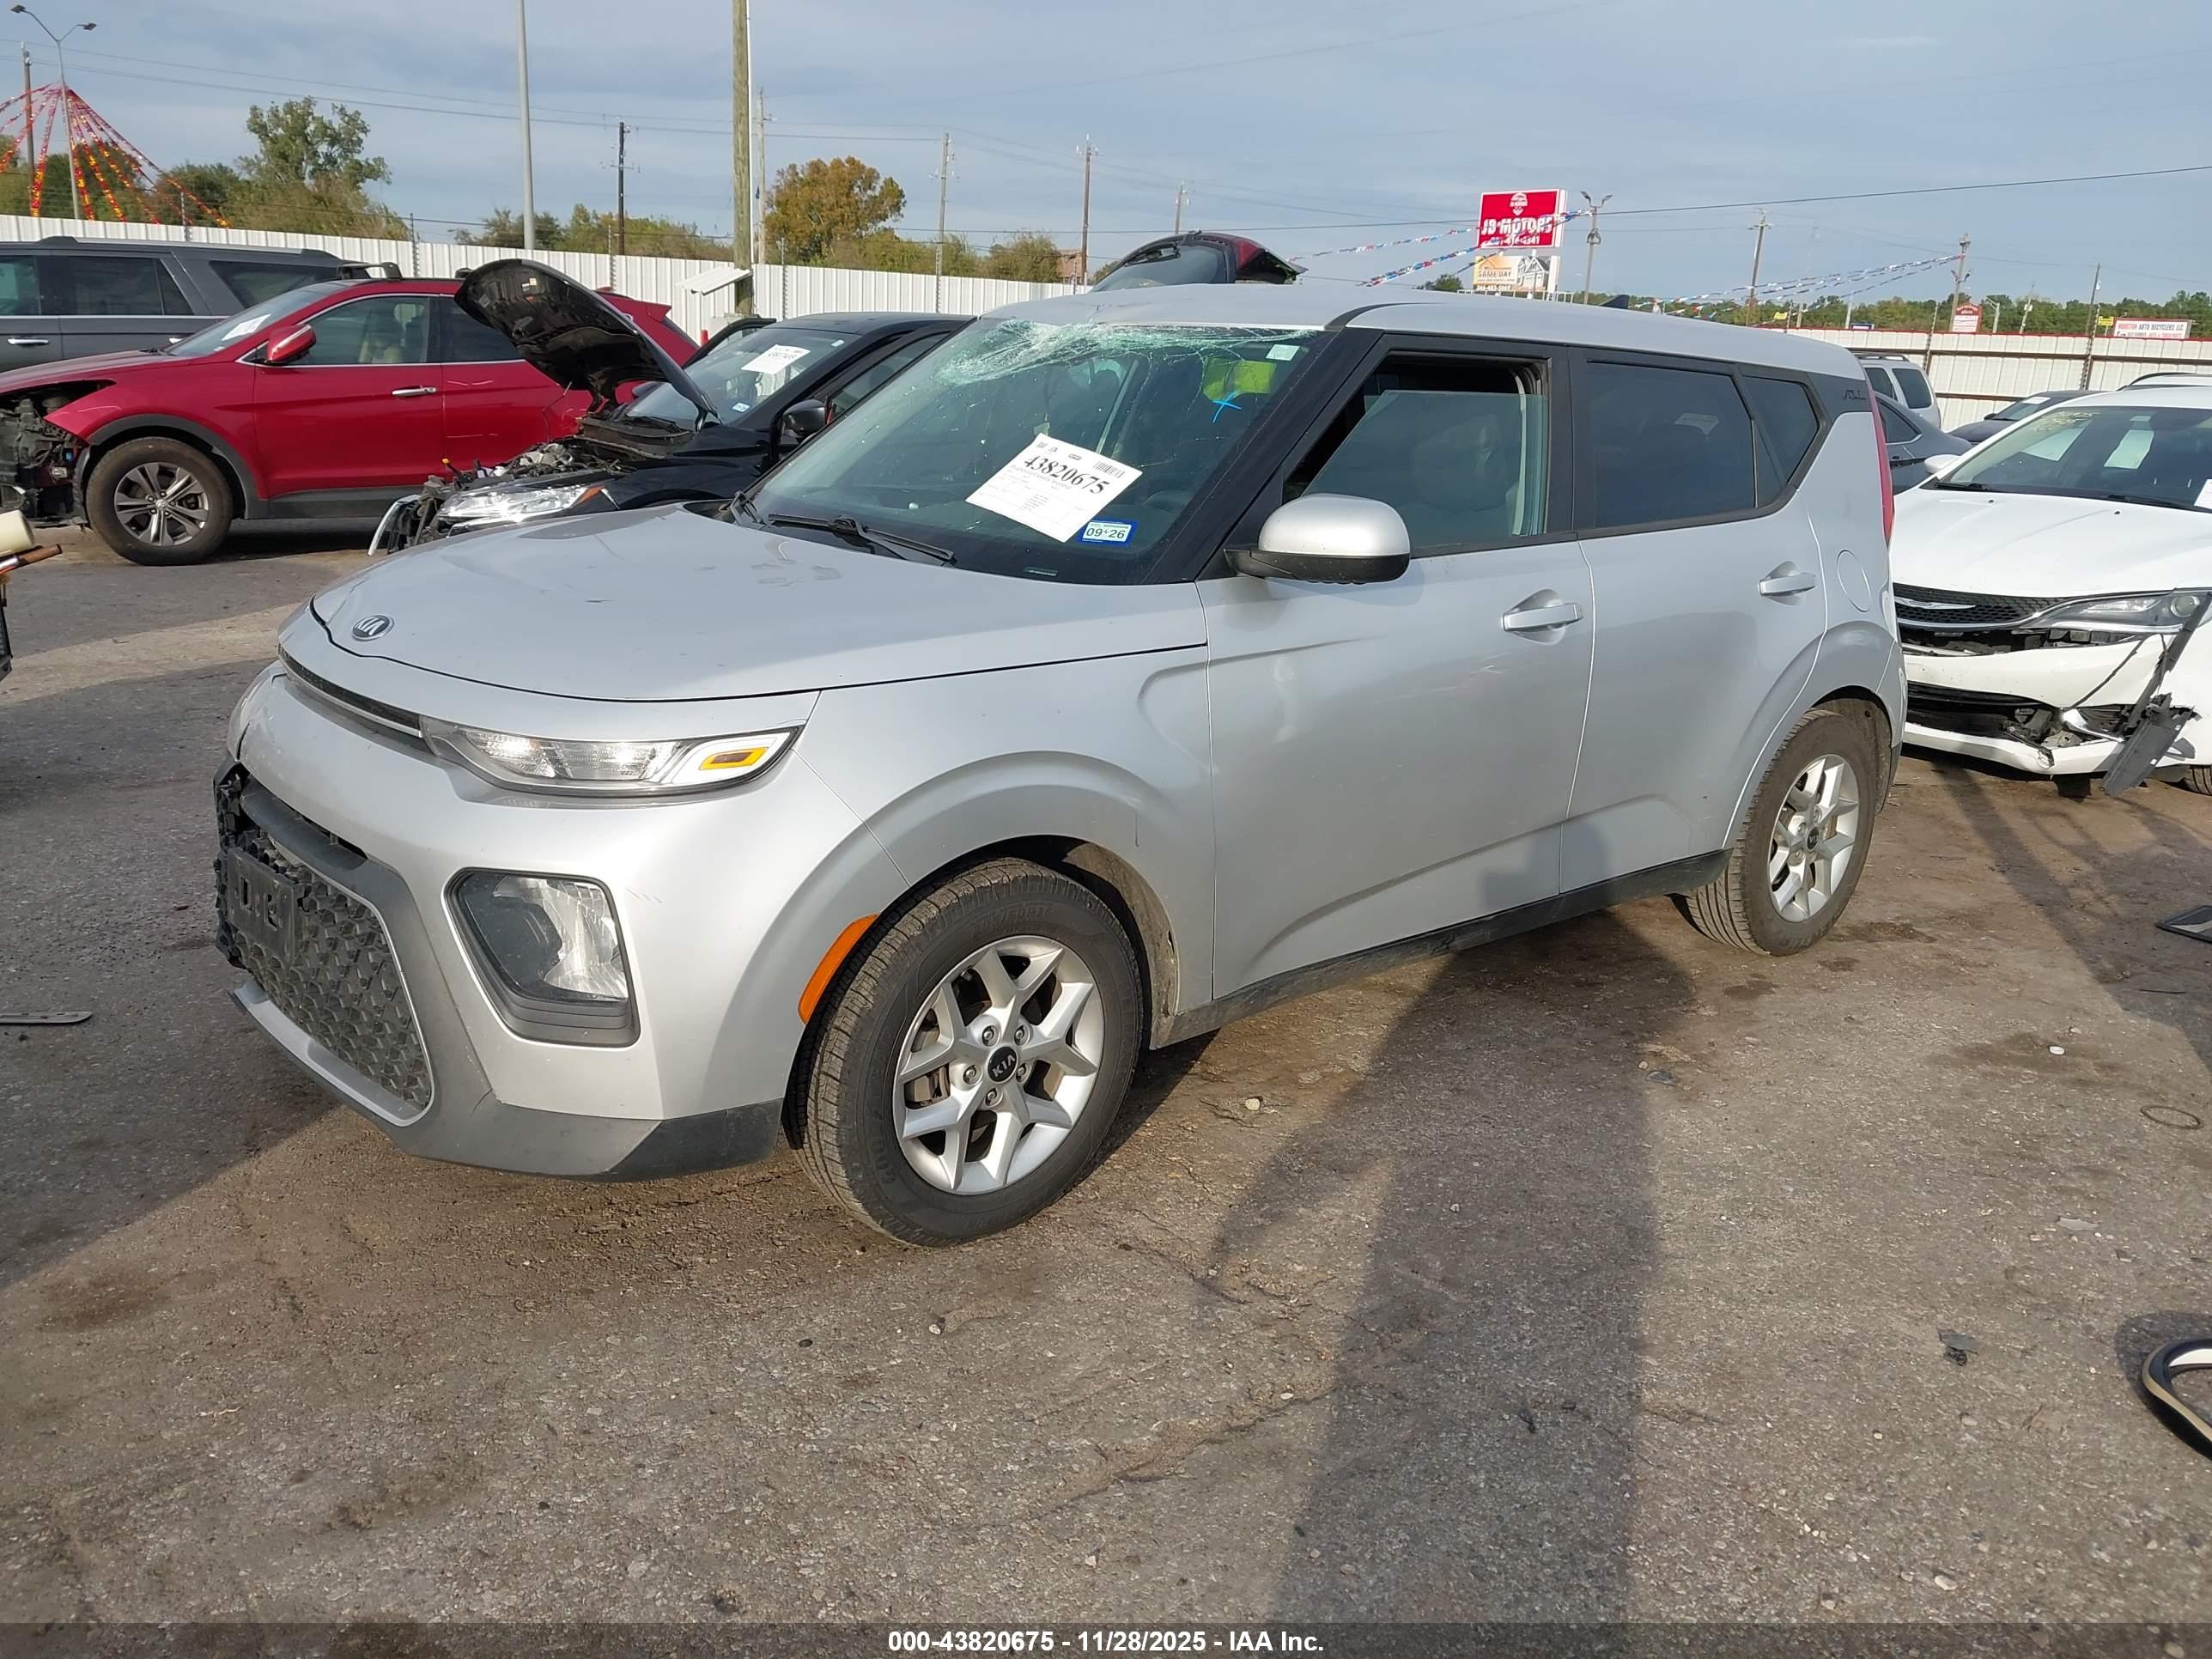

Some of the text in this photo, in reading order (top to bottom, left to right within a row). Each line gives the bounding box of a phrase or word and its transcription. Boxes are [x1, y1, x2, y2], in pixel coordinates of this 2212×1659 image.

[1499, 217, 1553, 234] MOTORS
[1478, 270, 1497, 278] SAME
[1024, 455, 1110, 495] 43820675
[1085, 527, 1127, 539] 09 26
[354, 617, 386, 635] KIA
[992, 1054, 1016, 1078] KIA
